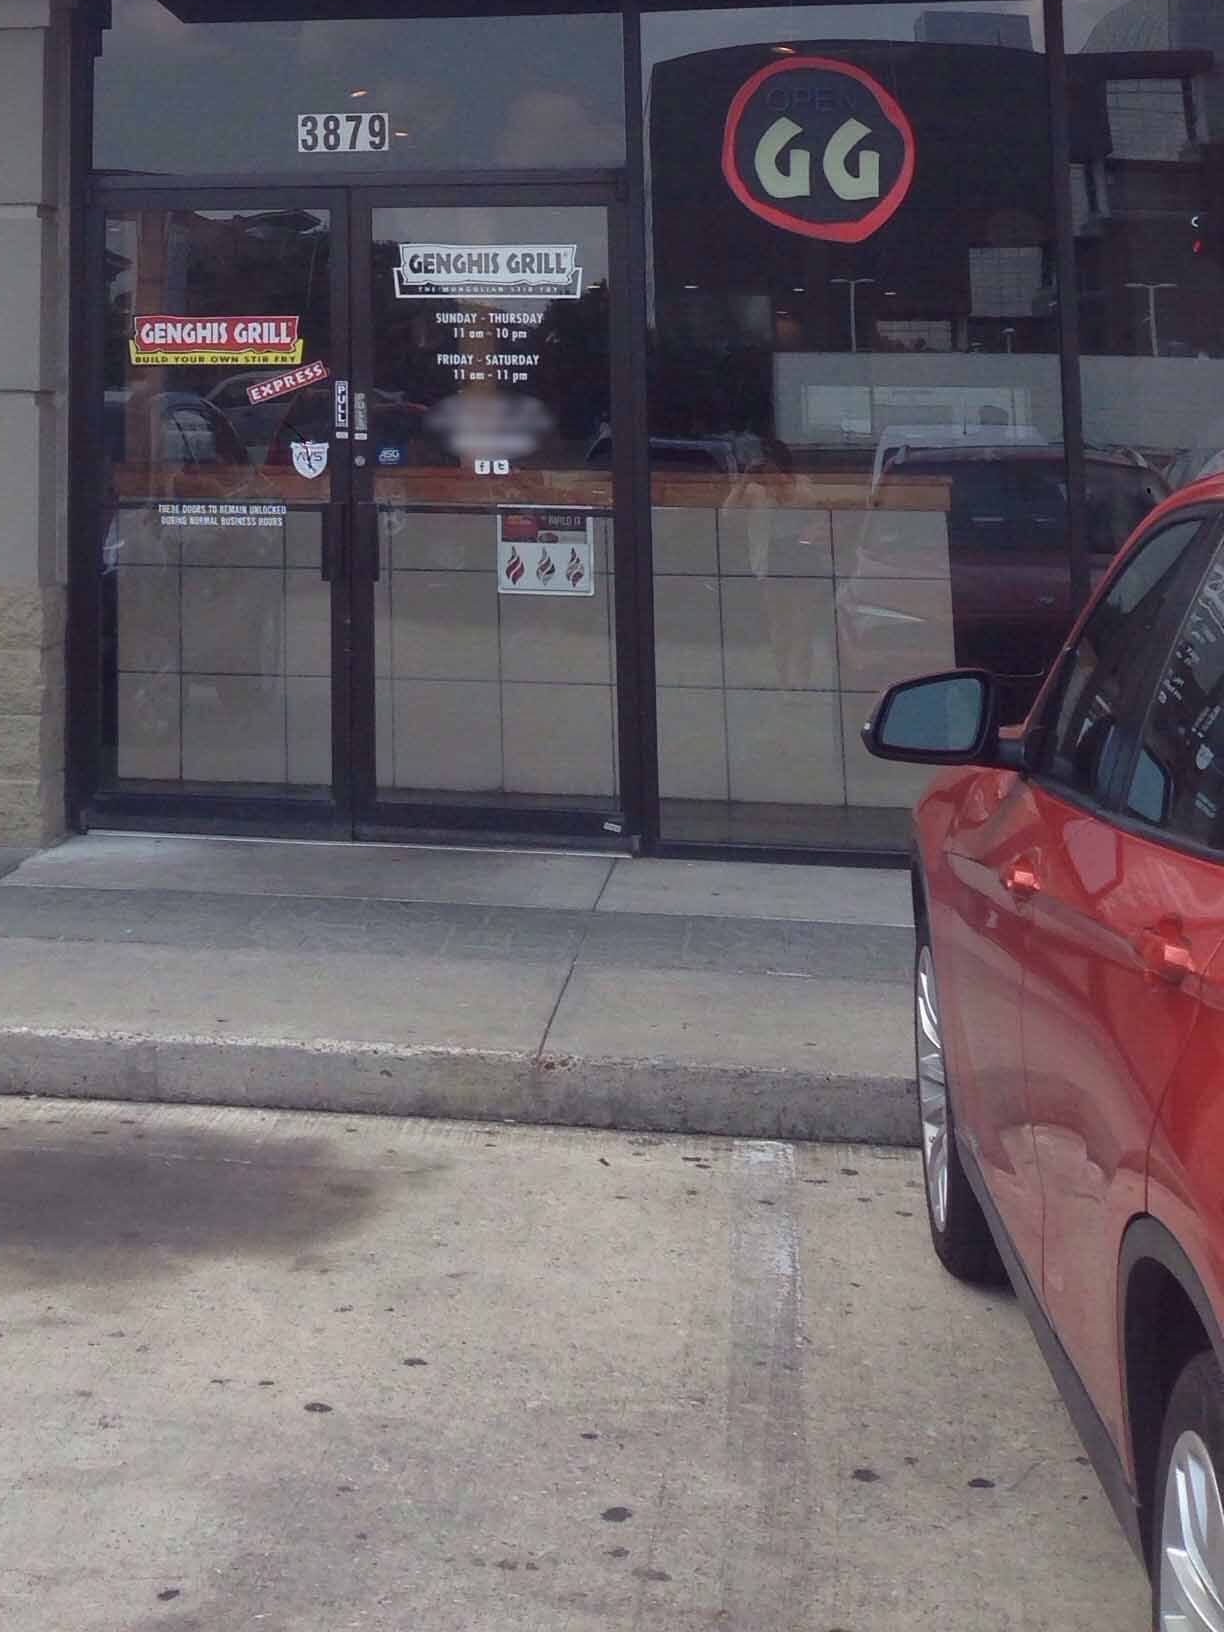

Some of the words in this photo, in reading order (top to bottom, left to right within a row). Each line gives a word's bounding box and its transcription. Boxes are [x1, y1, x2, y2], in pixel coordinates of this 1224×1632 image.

[301, 114, 386, 151] 3879
[755, 116, 880, 201] GG
[409, 253, 500, 274] GENGHIS
[506, 253, 567, 274] GRILL
[436, 313, 477, 324] SUNDAY
[488, 312, 544, 324] THURSDAY
[140, 322, 228, 344] GENGHIS
[234, 322, 293, 344] GRILL
[453, 327, 465, 338] 11
[496, 327, 509, 339] 10
[511, 330, 528, 342] pm
[437, 354, 473, 366] FRIDAY
[485, 354, 540, 366] SATURDAY
[250, 364, 324, 401] EXPRESS
[453, 369, 465, 380] 11
[496, 369, 509, 380] 11
[512, 372, 528, 384] pm
[337, 384, 347, 423] PULL
[182, 504, 206, 514] DOORS
[208, 505, 217, 514] TO
[219, 505, 247, 515] REMAIN
[249, 505, 287, 515] UNLOCKED
[189, 516, 218, 526] NORMAL
[220, 516, 257, 526] BUSINESS
[258, 517, 283, 527] HOURS
